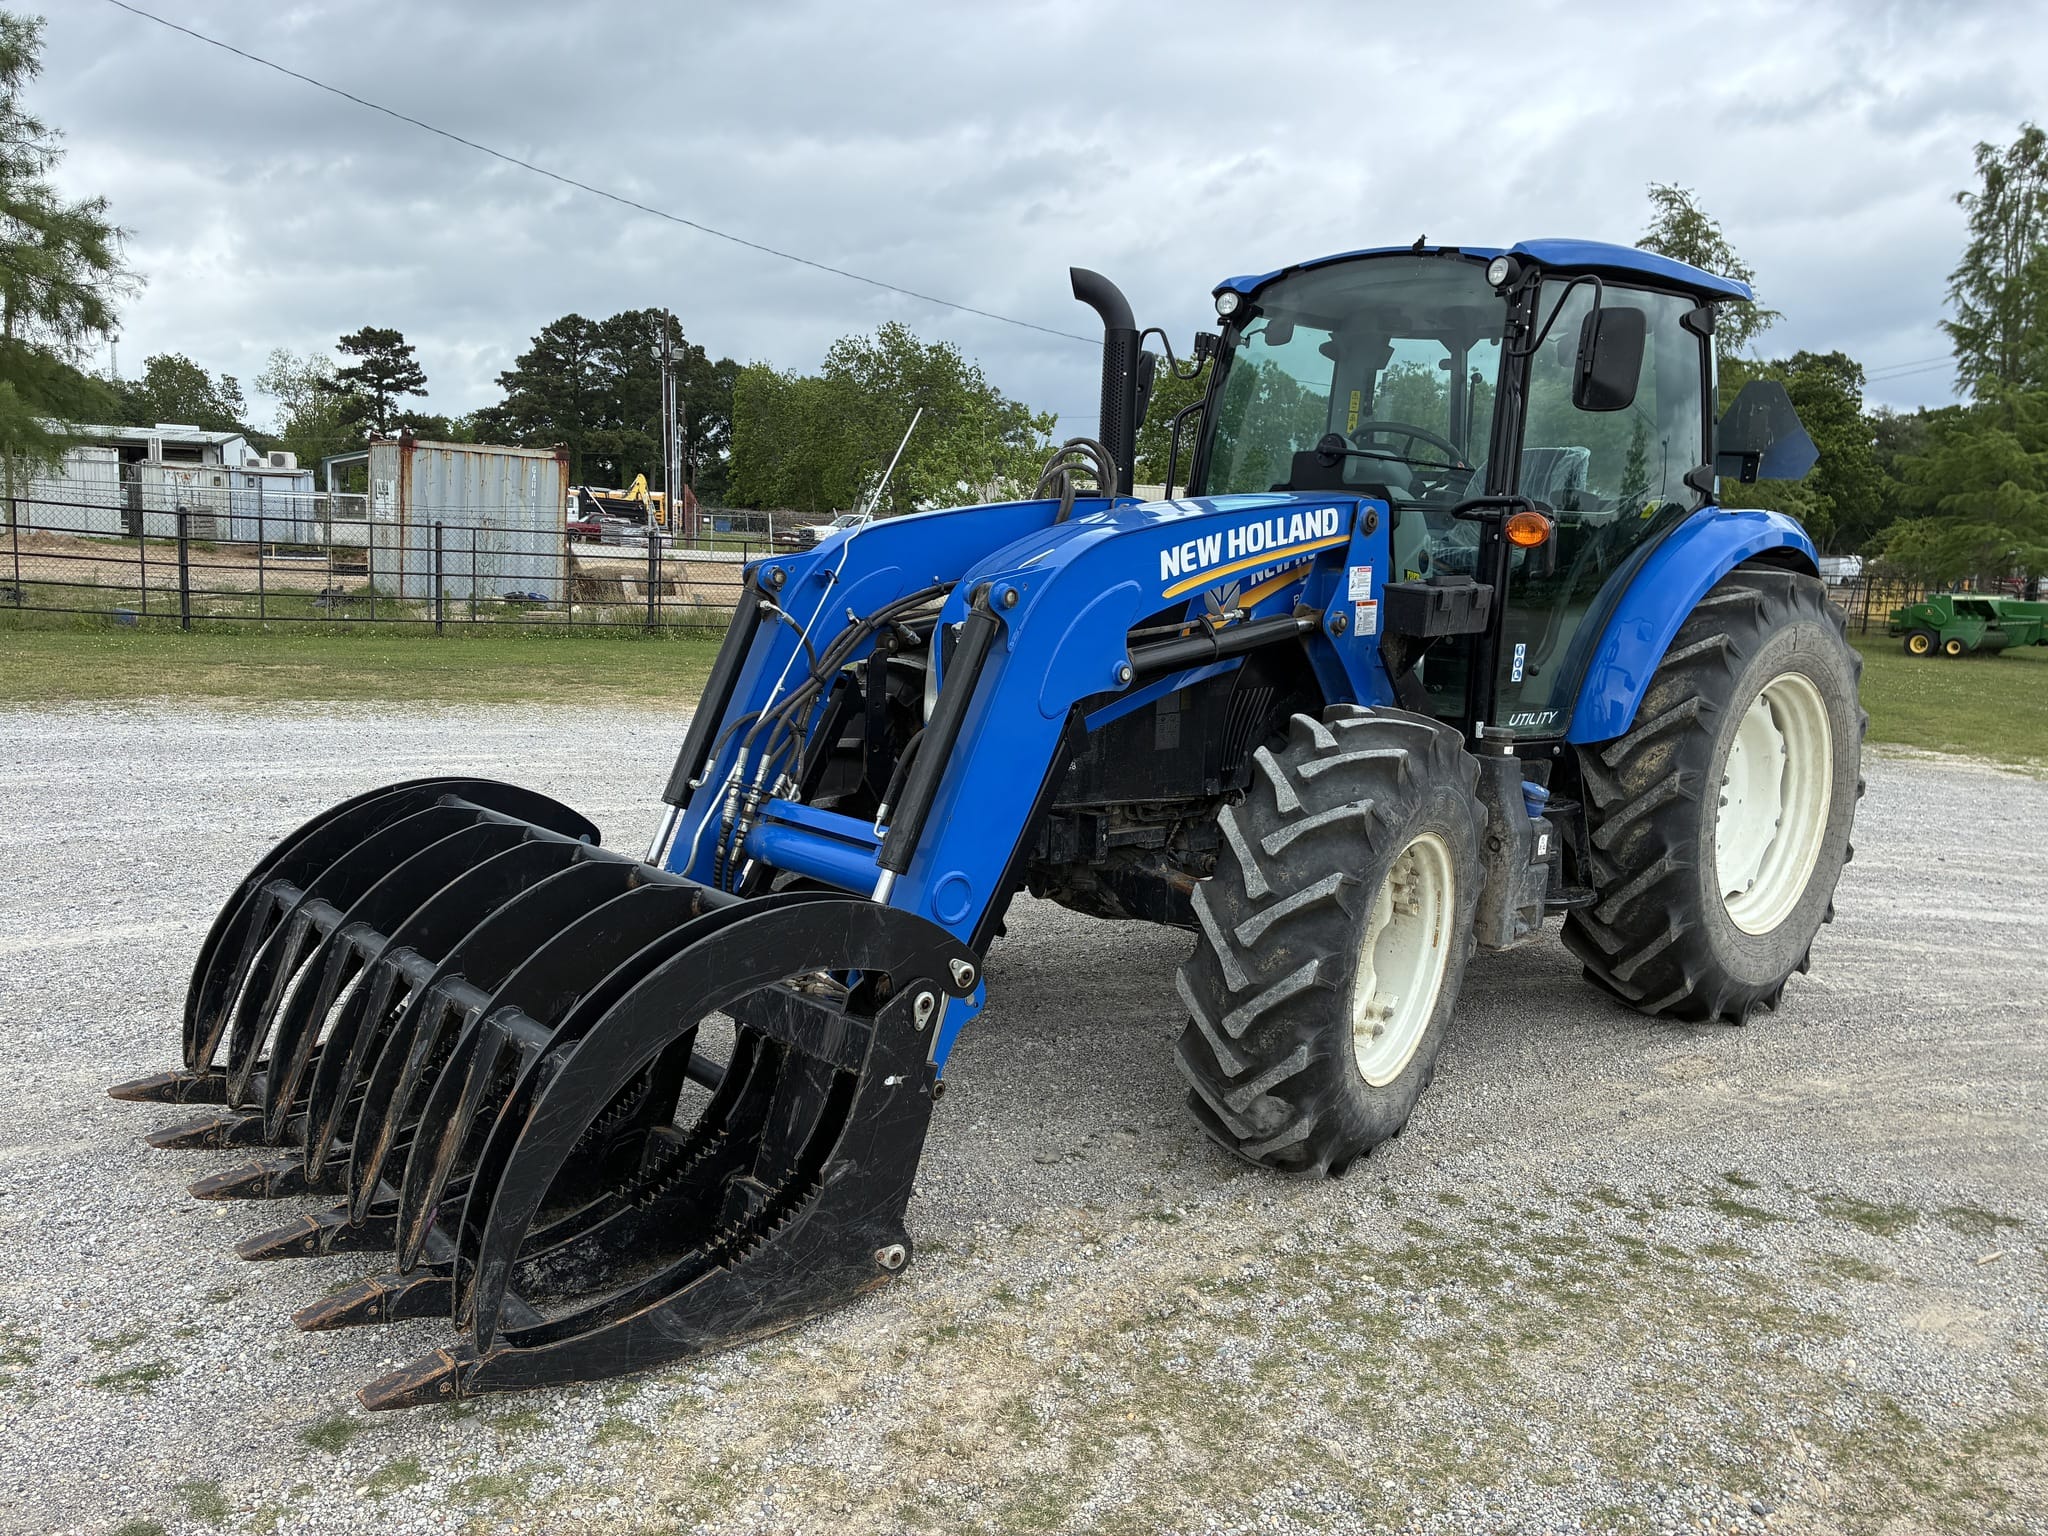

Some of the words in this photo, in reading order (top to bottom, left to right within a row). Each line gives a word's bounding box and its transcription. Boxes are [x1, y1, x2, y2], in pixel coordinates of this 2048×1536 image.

[1160, 532, 1222, 581] NEW
[1228, 507, 1338, 559] HOLLAND
[1509, 710, 1559, 726] UTILITY
